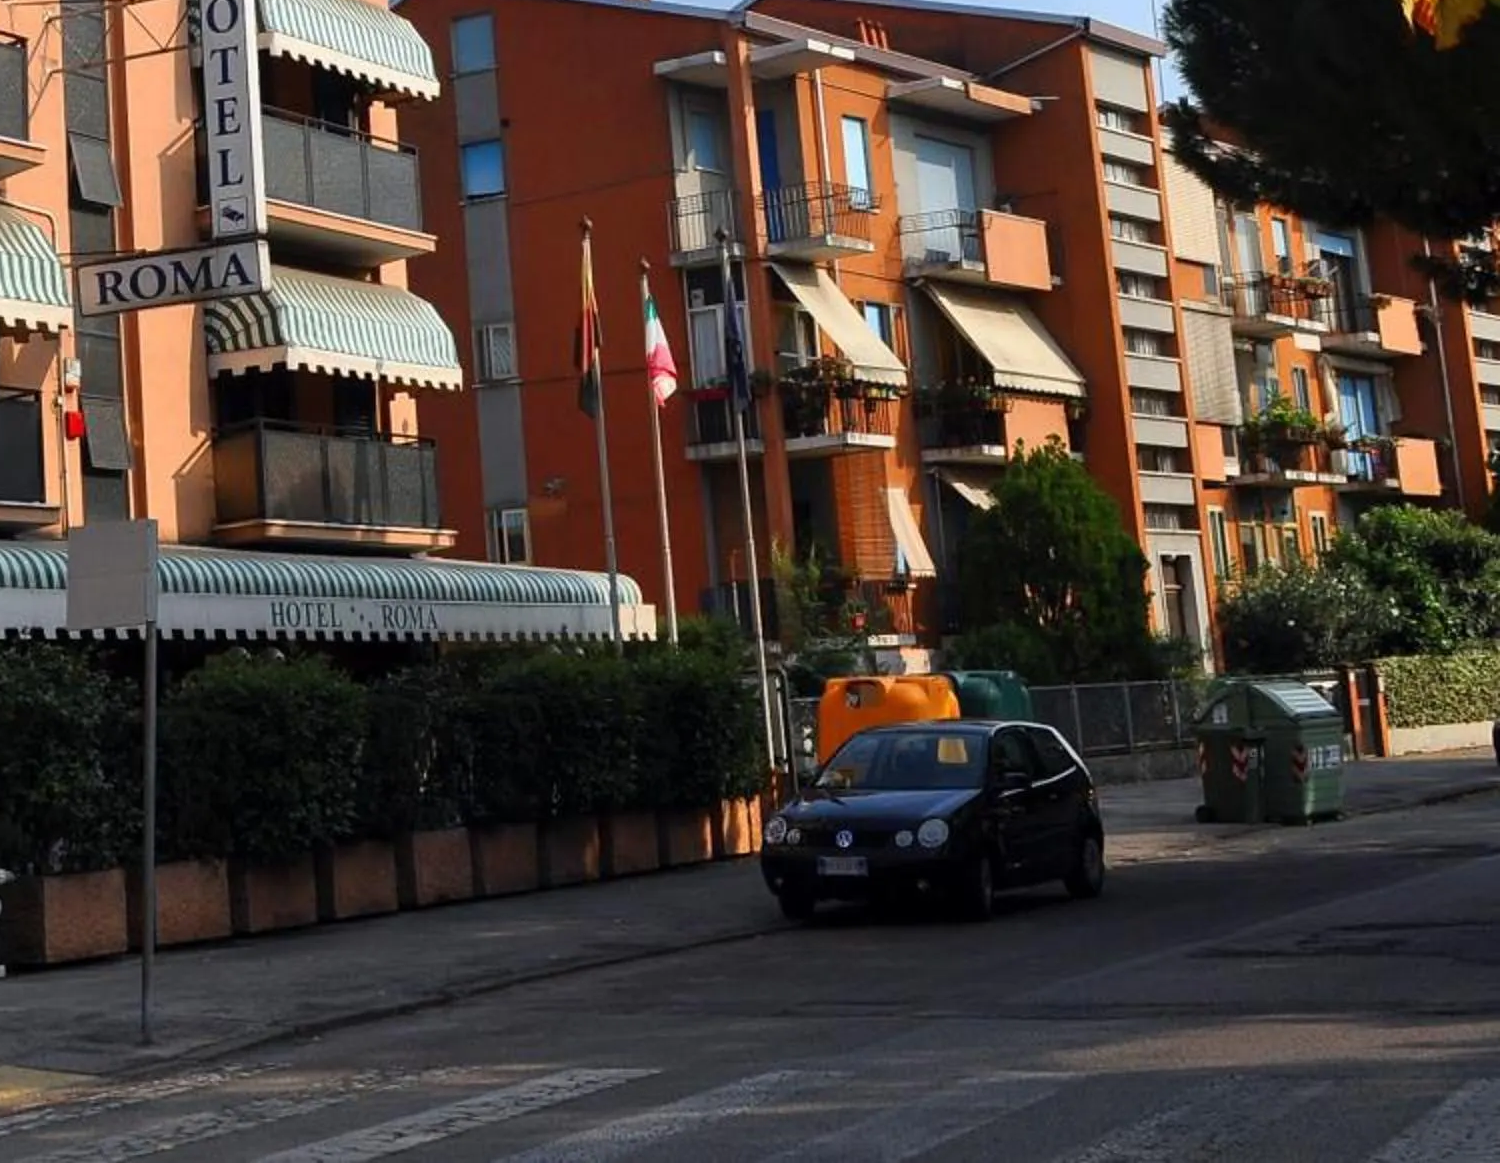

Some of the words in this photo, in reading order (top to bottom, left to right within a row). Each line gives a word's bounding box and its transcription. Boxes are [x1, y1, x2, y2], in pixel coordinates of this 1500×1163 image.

[96, 254, 253, 306] ROMA
[271, 602, 341, 627] HOTEL
[382, 605, 438, 629] ROMA
